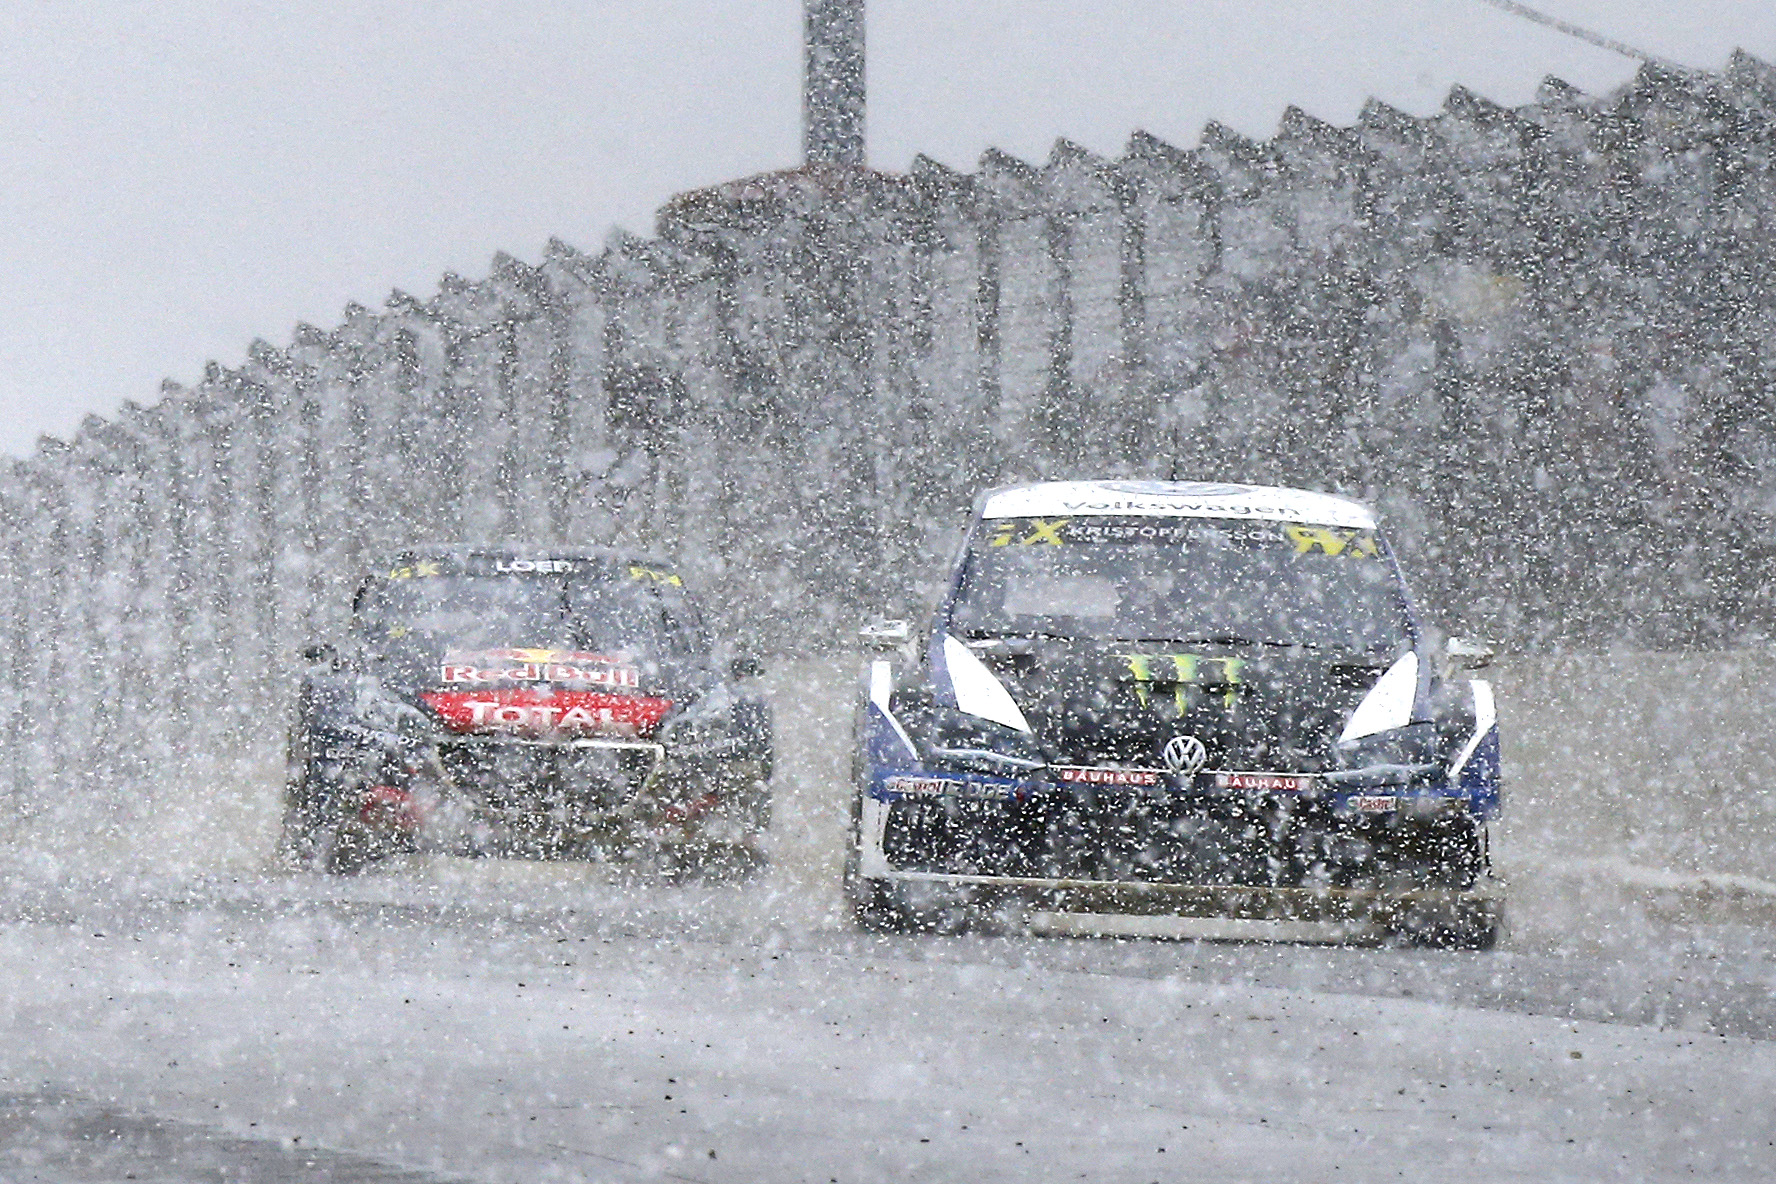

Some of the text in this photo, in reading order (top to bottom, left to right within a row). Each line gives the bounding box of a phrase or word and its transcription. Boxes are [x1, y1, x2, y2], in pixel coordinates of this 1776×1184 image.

[1062, 500, 1303, 518] Volkswagen
[1069, 525, 1285, 542] KRISTOFFESSON
[441, 663, 639, 687] Red Bull
[463, 701, 634, 729] TOTAL
[896, 779, 942, 794] Ctrol
[1062, 770, 1311, 790] BAUHAUS AUHAU
